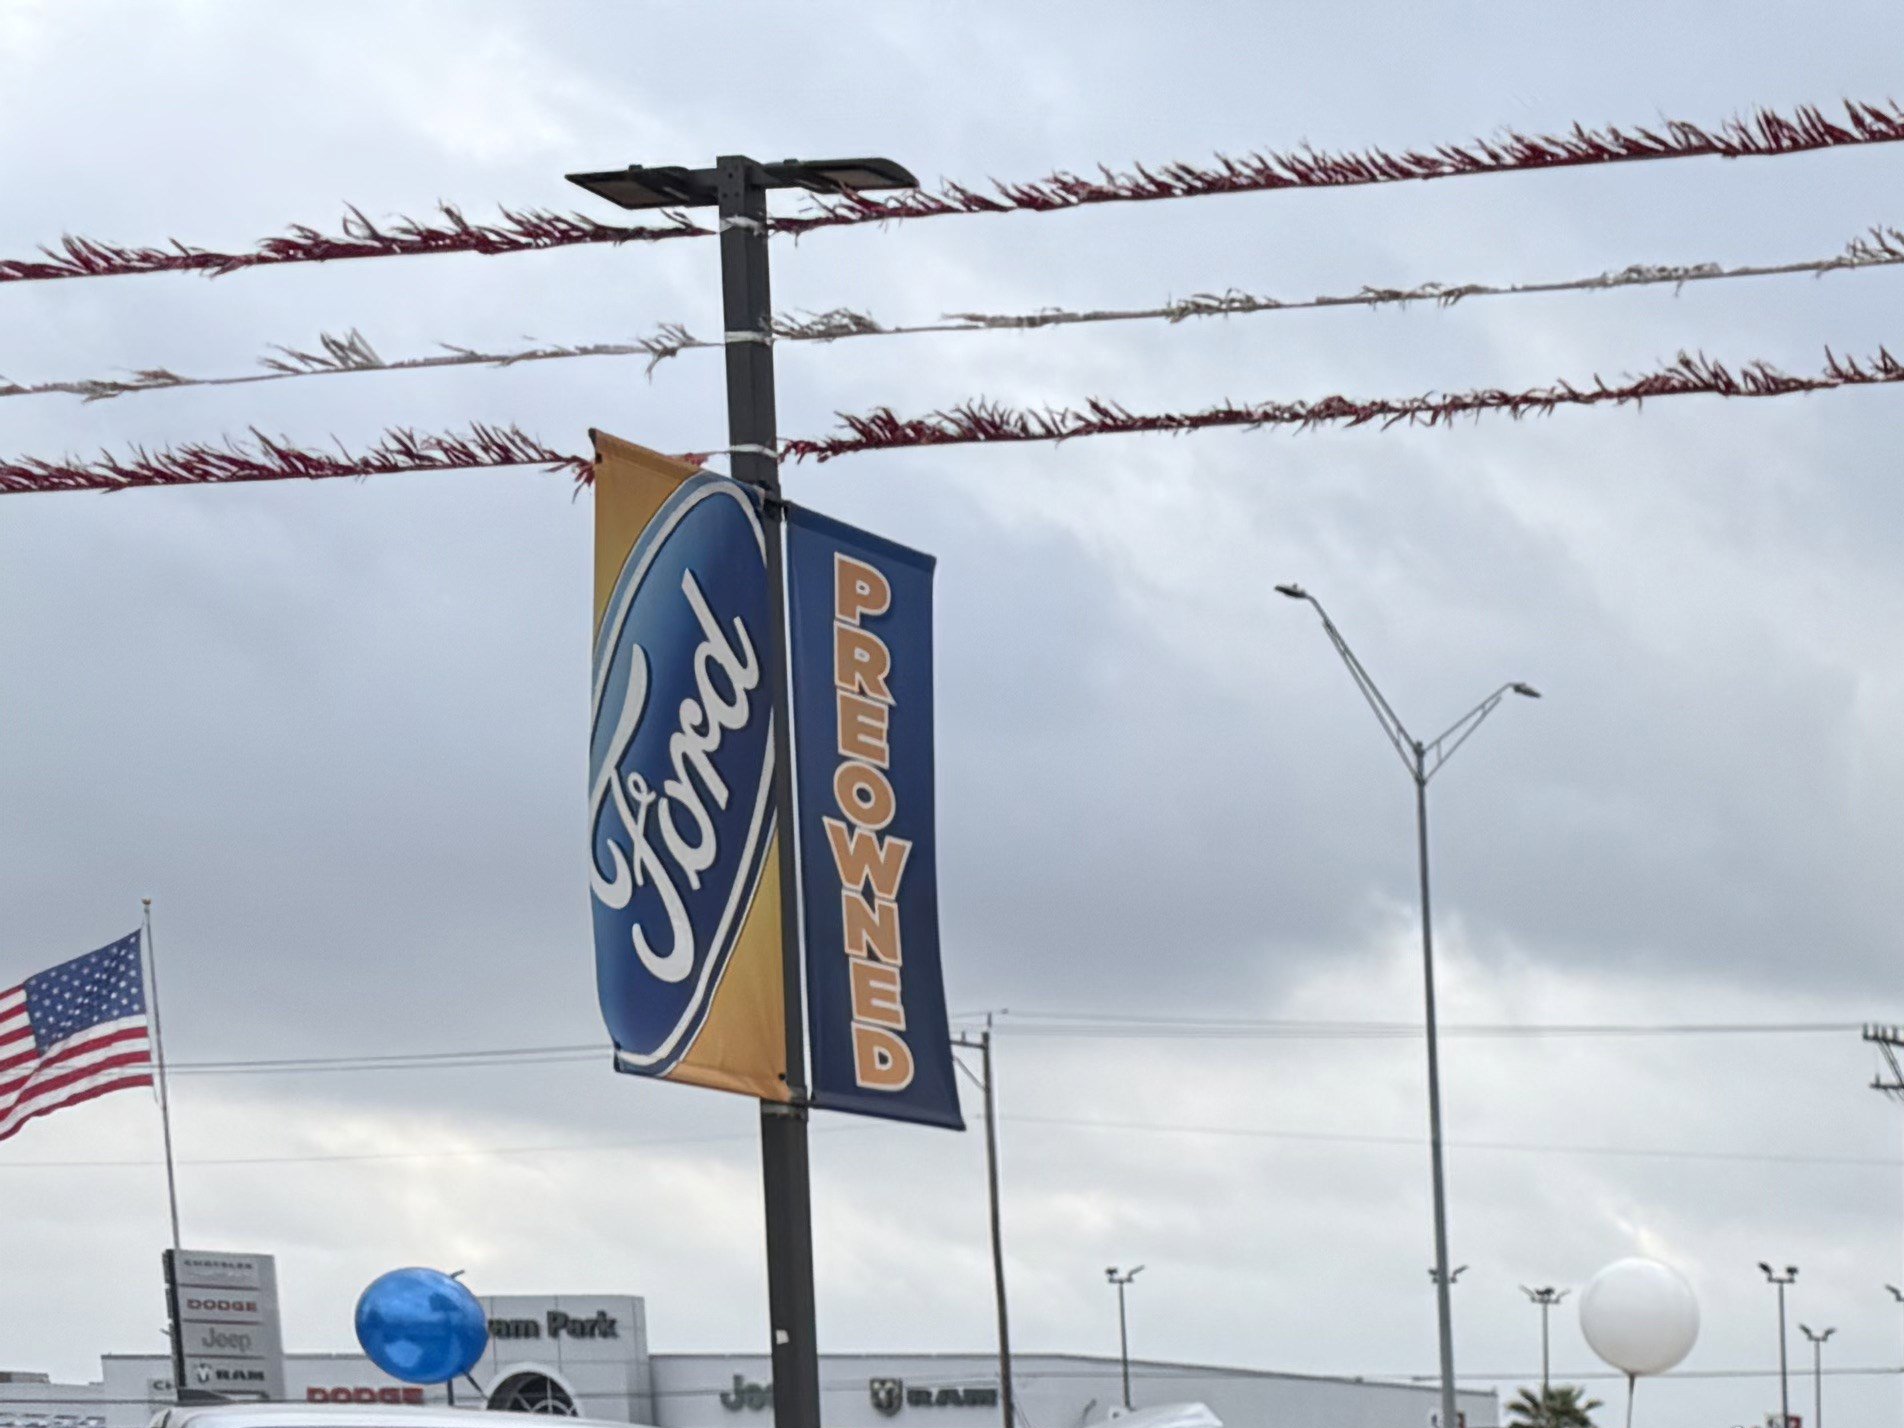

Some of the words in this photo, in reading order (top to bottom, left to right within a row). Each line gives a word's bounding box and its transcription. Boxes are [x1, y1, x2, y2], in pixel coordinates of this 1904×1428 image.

[590, 568, 760, 984] Ford
[822, 551, 914, 1092] PREOWNED
[186, 1299, 258, 1312] DODGE
[546, 1311, 620, 1339] Park
[201, 1326, 252, 1352] Jeep
[215, 1369, 265, 1381] RAM
[306, 1386, 424, 1404] DODGE
[906, 1388, 998, 1406] RAM
